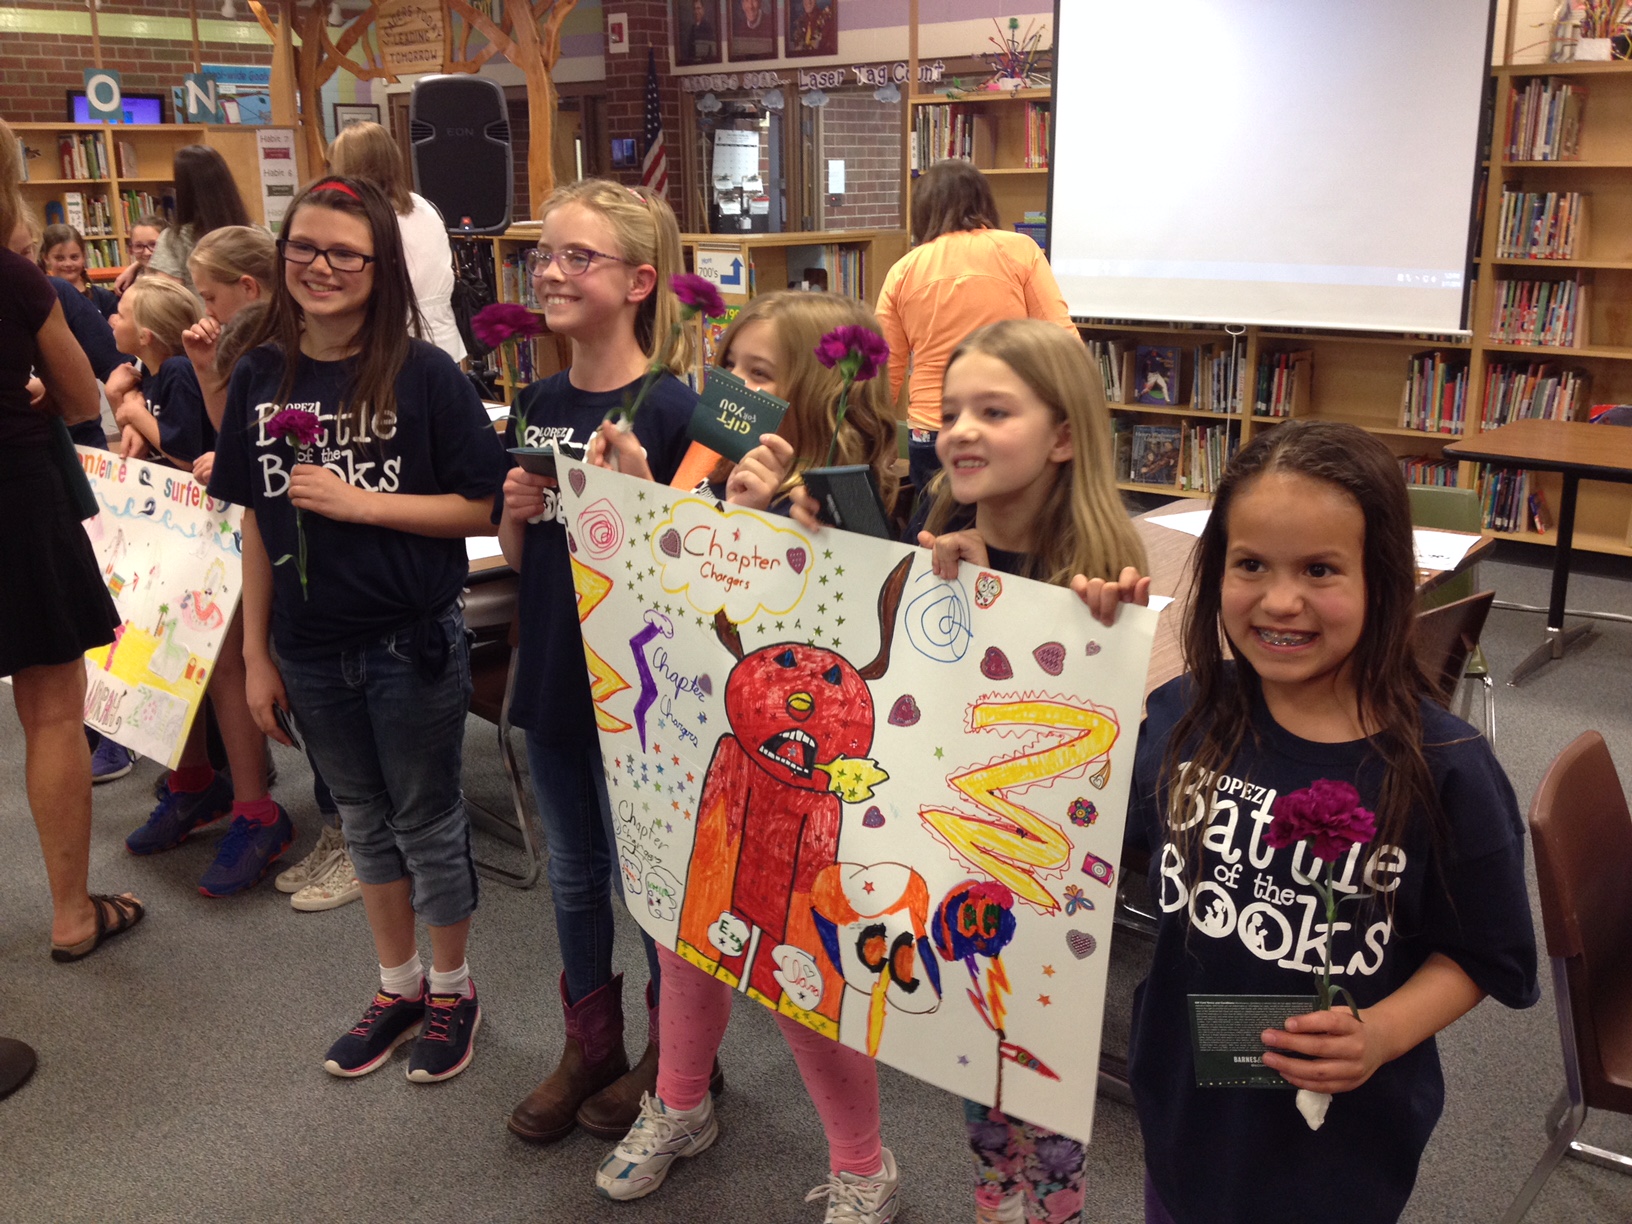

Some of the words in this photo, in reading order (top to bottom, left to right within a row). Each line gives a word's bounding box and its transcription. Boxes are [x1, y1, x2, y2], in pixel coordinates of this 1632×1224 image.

[390, 49, 438, 64] TOMORROW
[798, 69, 845, 90] Laser
[852, 65, 888, 87] Tag
[86, 74, 121, 113] O
[184, 79, 217, 115] N
[260, 135, 282, 143] Habit
[263, 169, 285, 177] Habit
[698, 266, 719, 279] 700's
[719, 398, 746, 419] YOU
[716, 410, 752, 435] GIFT
[297, 448, 314, 464] of
[321, 447, 342, 464] the
[163, 477, 215, 512] surfers
[683, 525, 781, 574] Chapter
[653, 646, 705, 703] Chapter
[618, 799, 670, 851] Chapter
[1213, 862, 1244, 890] of
[1253, 872, 1295, 907] the
